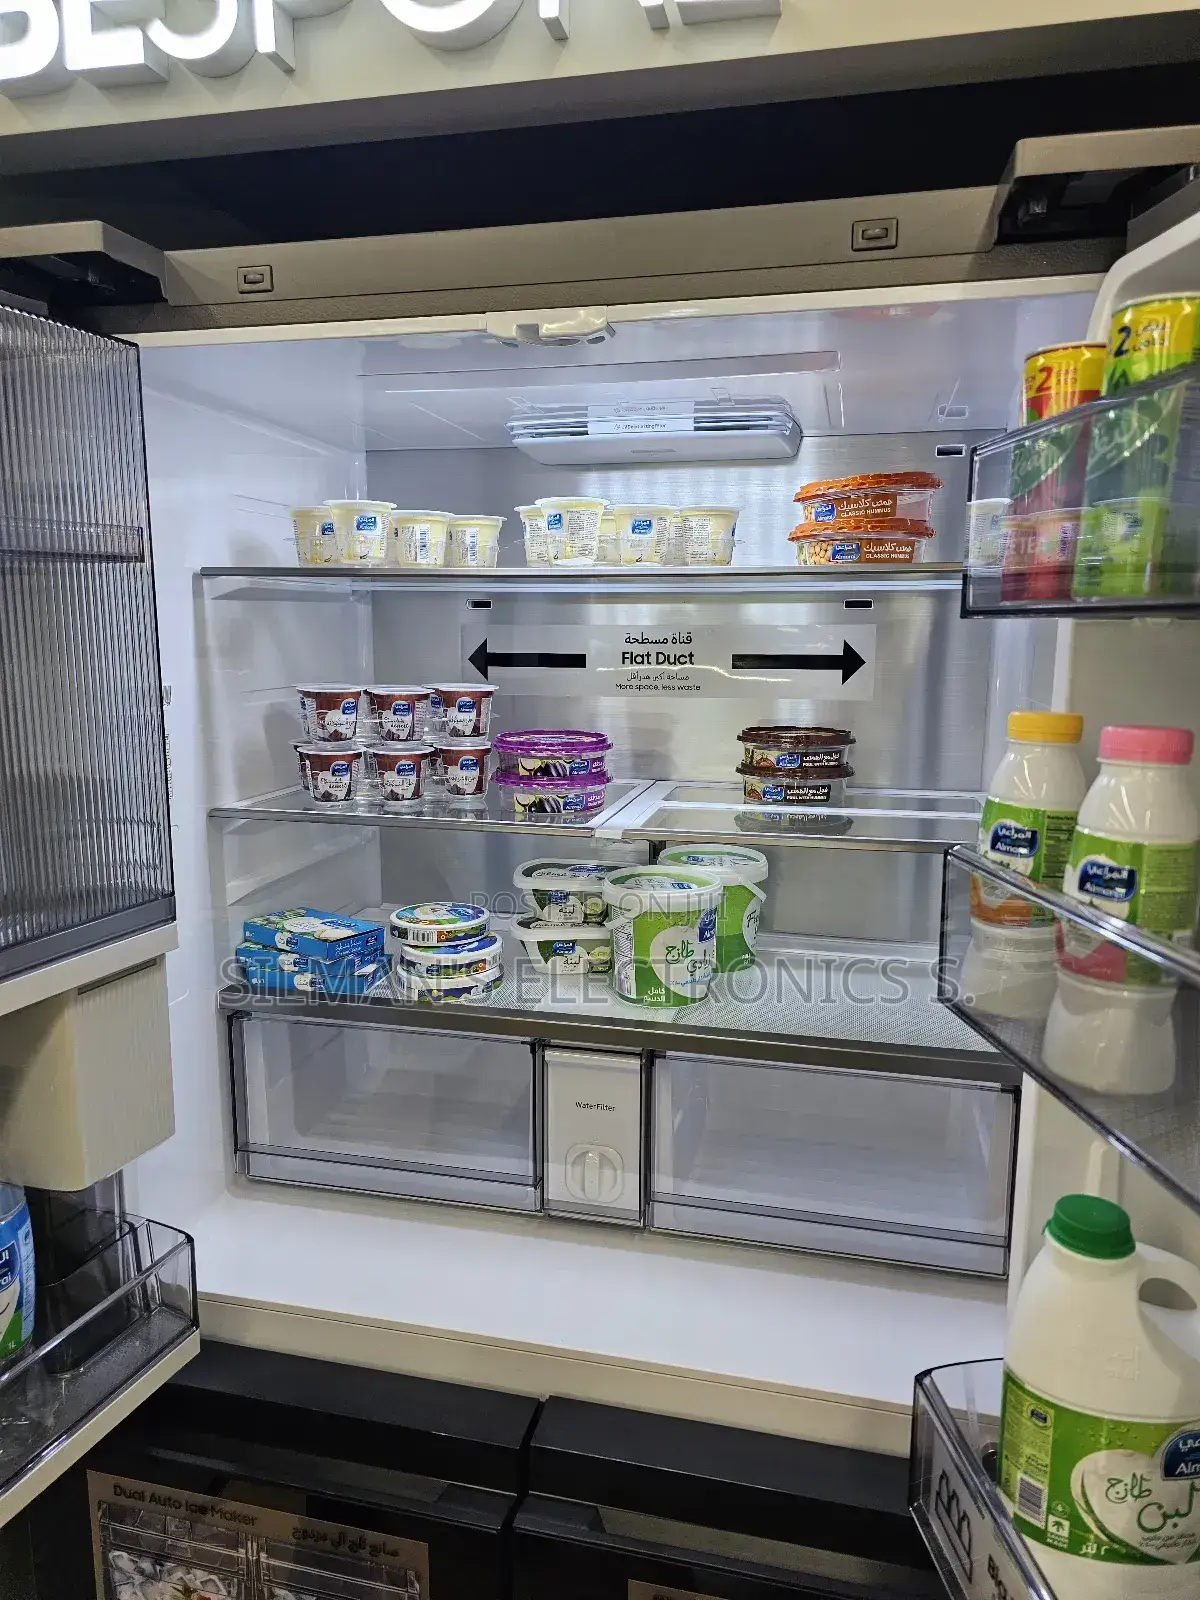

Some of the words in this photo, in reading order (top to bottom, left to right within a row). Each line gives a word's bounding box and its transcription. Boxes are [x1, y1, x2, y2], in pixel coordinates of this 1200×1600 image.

[1113, 324, 1132, 359] 2
[1035, 365, 1053, 393] 2
[624, 631, 669, 645] مسطحة
[671, 631, 693, 645] قناة
[621, 651, 652, 665] Flat
[655, 651, 695, 665] Duct
[615, 683, 634, 691] More
[661, 683, 676, 691] less
[997, 826, 1032, 839] المراعي
[995, 842, 1030, 855] Alma
[1105, 1472, 1152, 1504] طازج
[113, 1482, 146, 1503] Dual
[148, 1492, 183, 1510] Auto
[185, 1500, 208, 1516] Ice
[211, 1505, 259, 1527] Maker
[1137, 1480, 1200, 1533] لبن
